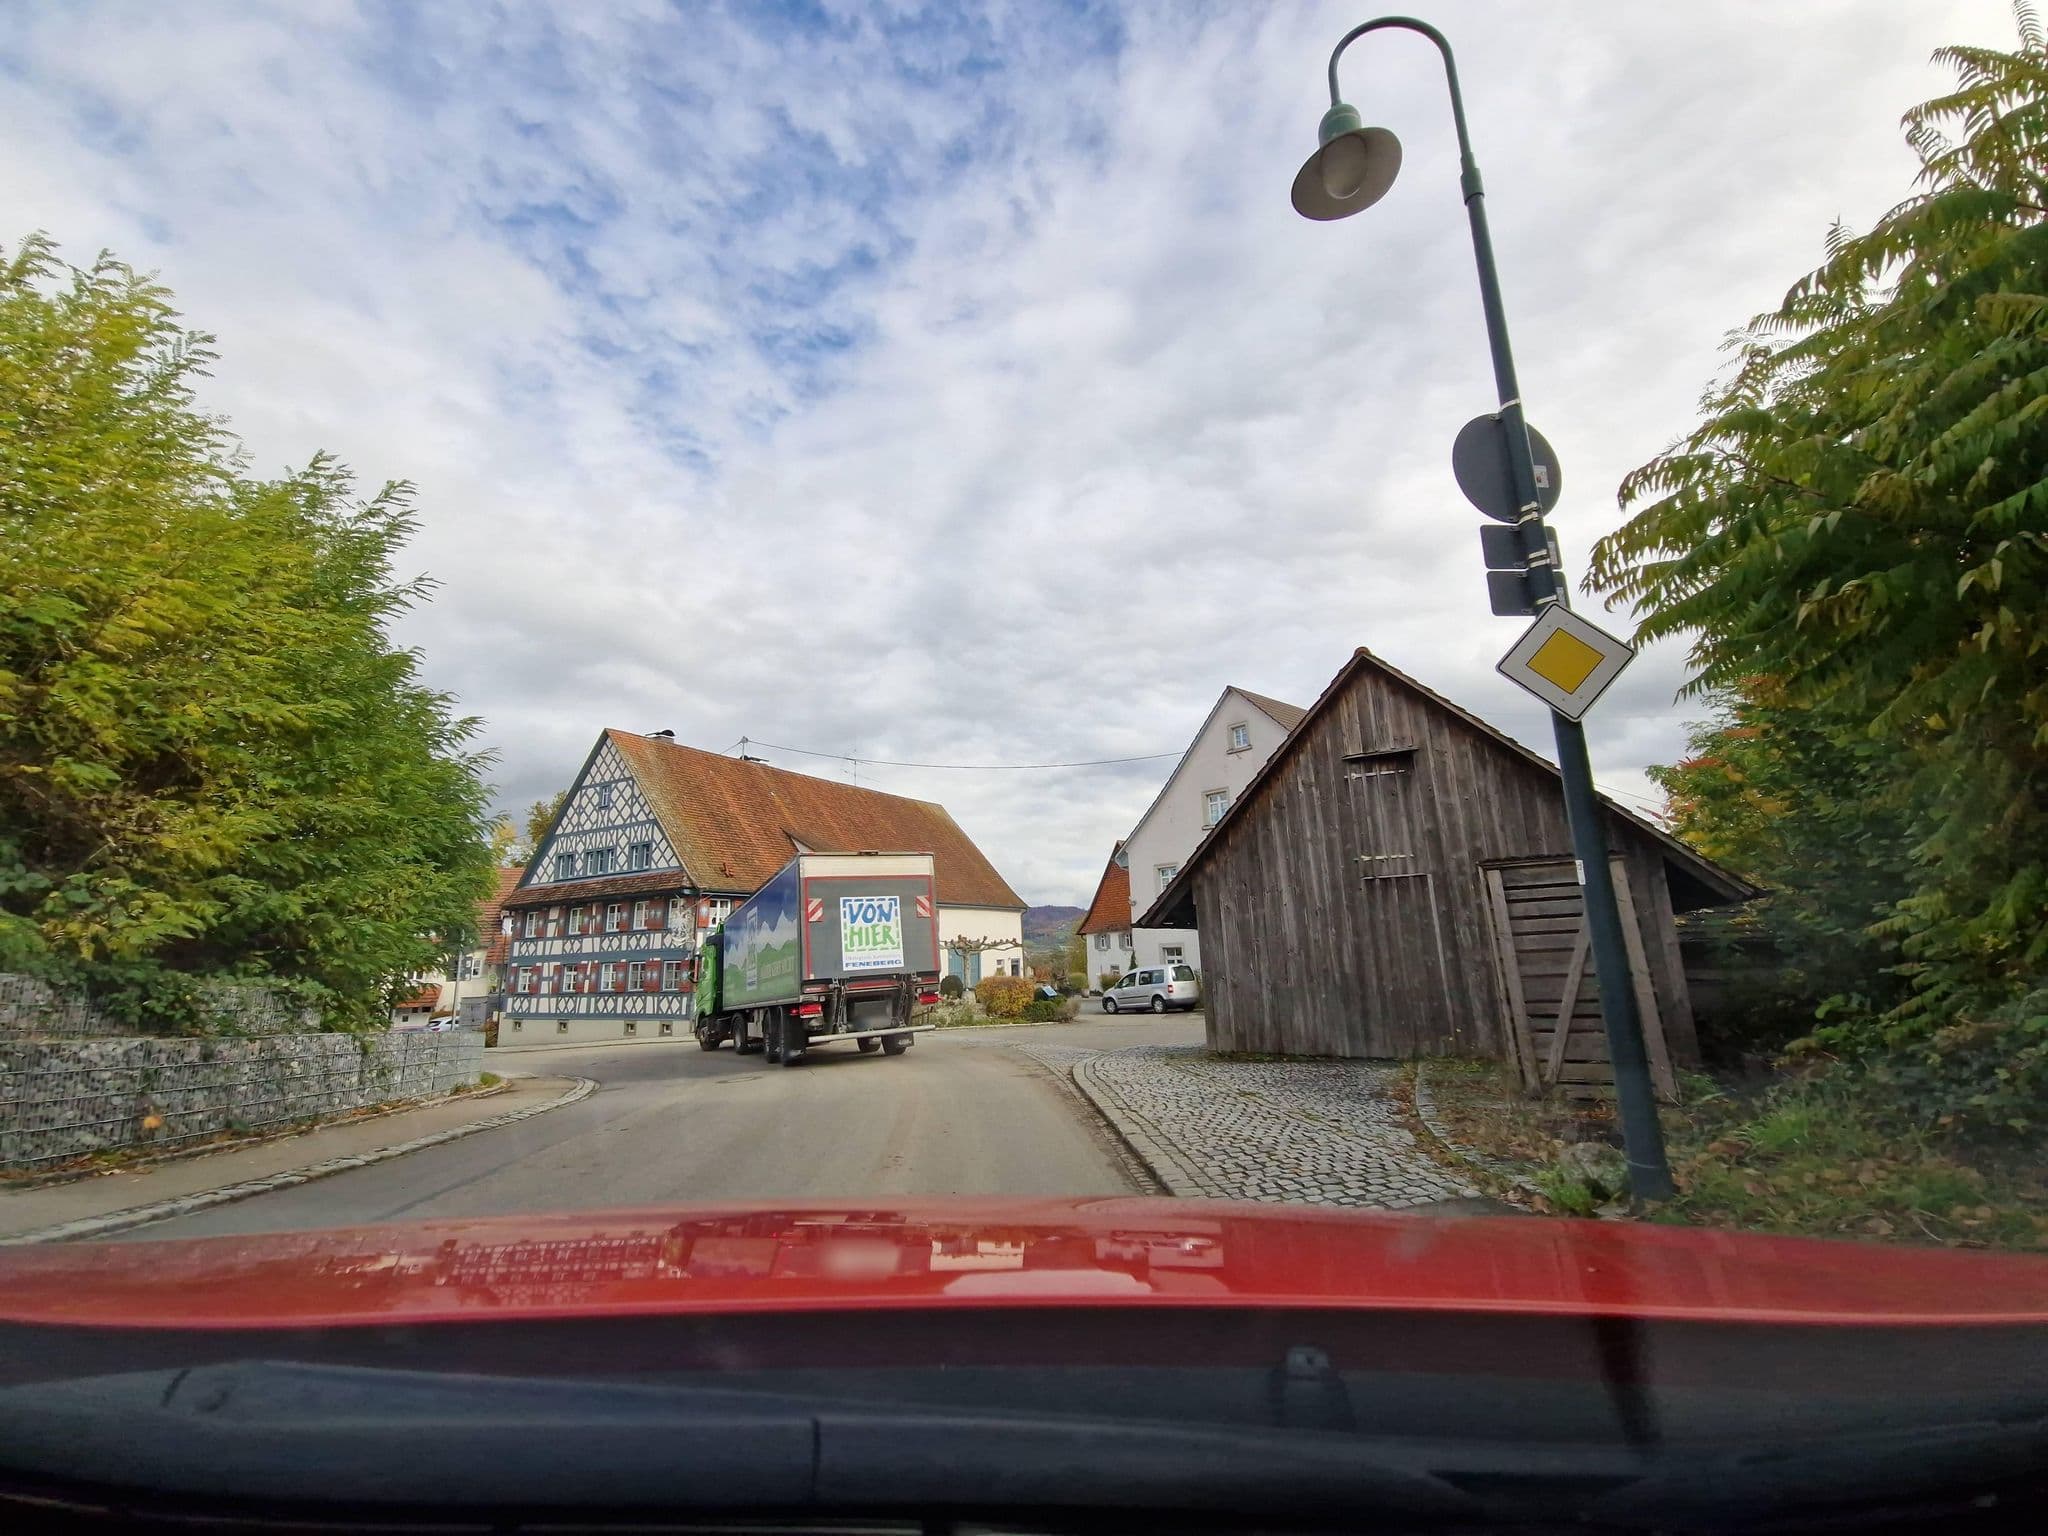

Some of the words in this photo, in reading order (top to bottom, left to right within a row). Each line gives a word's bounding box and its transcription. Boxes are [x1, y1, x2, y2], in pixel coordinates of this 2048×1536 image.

[849, 902, 893, 924] VON
[849, 924, 896, 948] HIER
[845, 959, 902, 968] FENEBERG
